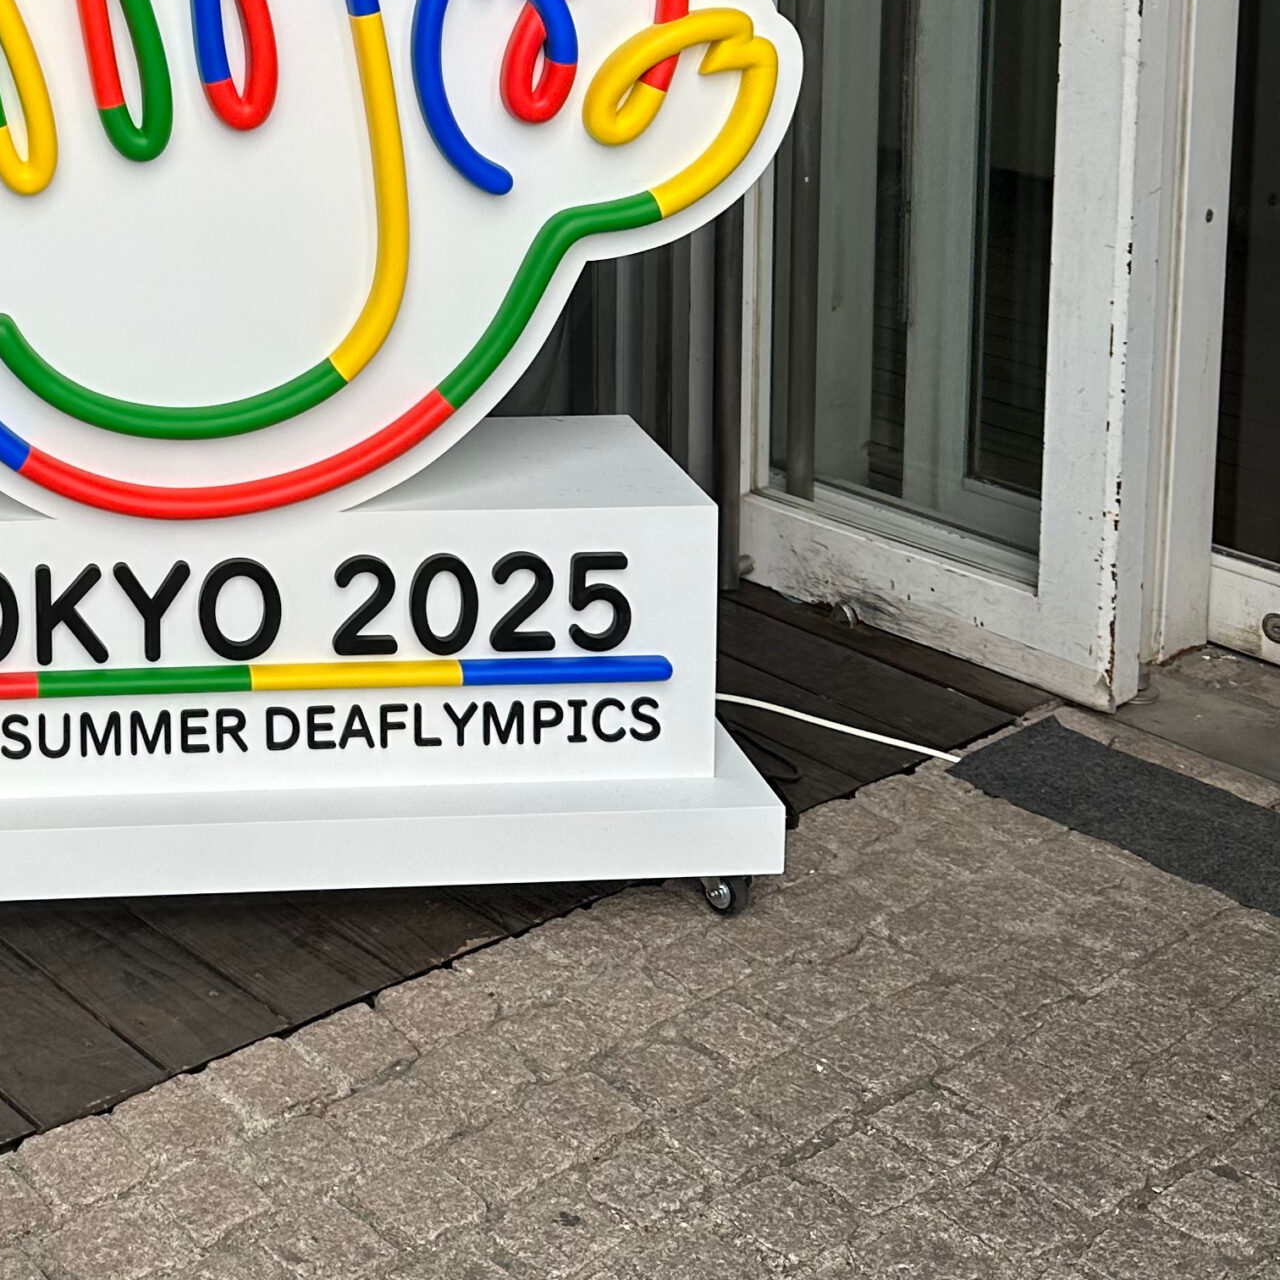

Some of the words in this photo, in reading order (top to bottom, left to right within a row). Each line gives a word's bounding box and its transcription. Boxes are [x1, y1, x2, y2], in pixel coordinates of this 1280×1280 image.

[332, 550, 632, 656] 2025
[0, 708, 249, 760] SUMMER
[265, 696, 661, 752] DEAFLYMPICS
